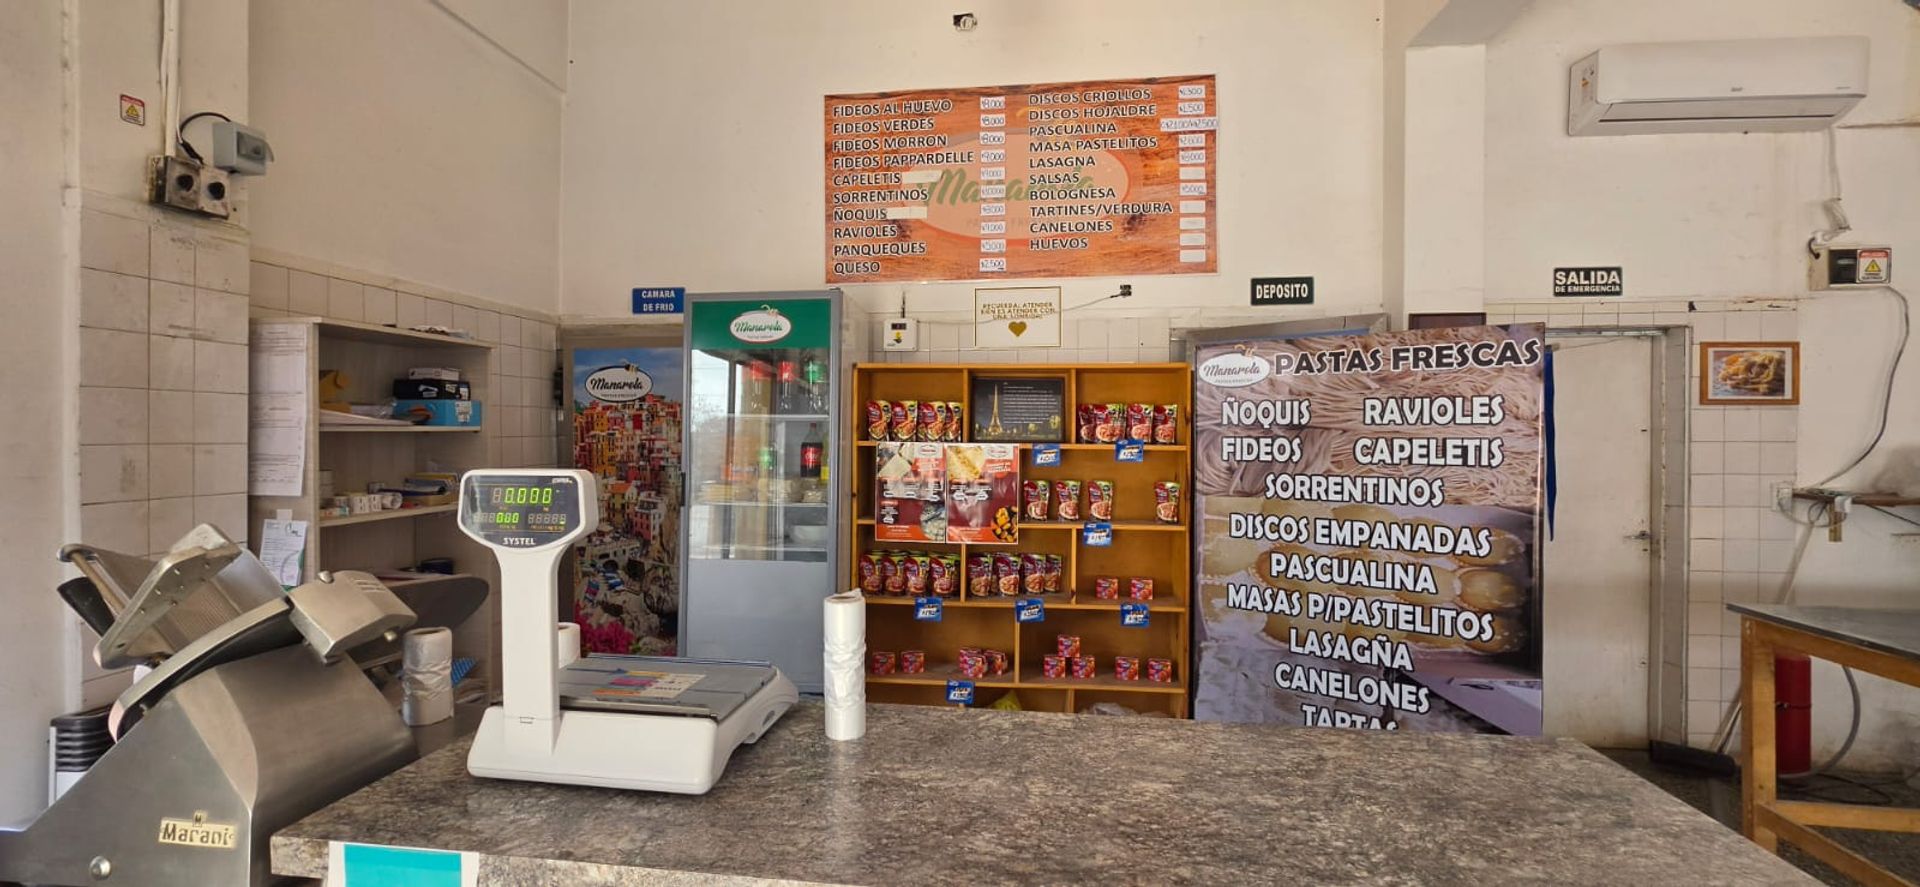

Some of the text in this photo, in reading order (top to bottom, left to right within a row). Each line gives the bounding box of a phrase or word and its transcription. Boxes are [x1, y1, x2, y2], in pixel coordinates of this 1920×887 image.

[1029, 89, 1152, 105] DISCOS CRIOLLOS
[833, 99, 952, 117] FIDEOS AL HUEVO
[1029, 104, 1156, 120] DISCOS HOJALDRE
[833, 118, 934, 134] FIDEOS VERDES
[1029, 122, 1116, 136] PASCUALINA
[833, 135, 947, 152] FIDEOS MORRON
[1029, 136, 1158, 153] MASA PASTELITOS
[833, 151, 974, 168] FIDEOS PAPPARDELLE
[1029, 156, 1096, 168] LASAGNA
[833, 172, 901, 186] CAPELETIS
[1029, 172, 1080, 184] SALSAS
[833, 188, 928, 204] SORRENTINOS
[1030, 188, 1116, 201] BOLOGNESA
[833, 206, 887, 222] ÑOQUIS
[1030, 202, 1172, 217] TARTINES/VERDURA
[833, 225, 897, 238] RAVIOLES
[1030, 220, 1113, 234] CANELONES
[833, 242, 926, 256] PANQUEQUES
[1030, 237, 1088, 250] HUEVOS
[834, 261, 880, 274] QUESO
[1555, 270, 1620, 285] SALIDA
[641, 290, 676, 298] CAMARA
[1256, 283, 1308, 299] DEPOSITO
[655, 303, 674, 311] FRIO
[734, 320, 783, 332] Manarola
[1274, 338, 1542, 377] PASTAS FRESCAS
[1203, 362, 1260, 377] Manarola
[590, 377, 642, 390] Manarola
[1221, 394, 1504, 429] ÑOQUIS RAVIOLES
[1221, 436, 1504, 468] FIDEOS CAPELETIS
[1265, 474, 1444, 507] SORRENTINOS
[502, 537, 536, 546] SYSTEL
[1229, 513, 1492, 558] DISCOS EMPANADAS
[1270, 552, 1437, 595] PASCUALINA
[1228, 584, 1494, 642] MASAS P/PASTELITOS
[1289, 627, 1414, 672] LASAGÑA
[1275, 663, 1430, 714] CANELONES
[162, 822, 230, 846] Marani
